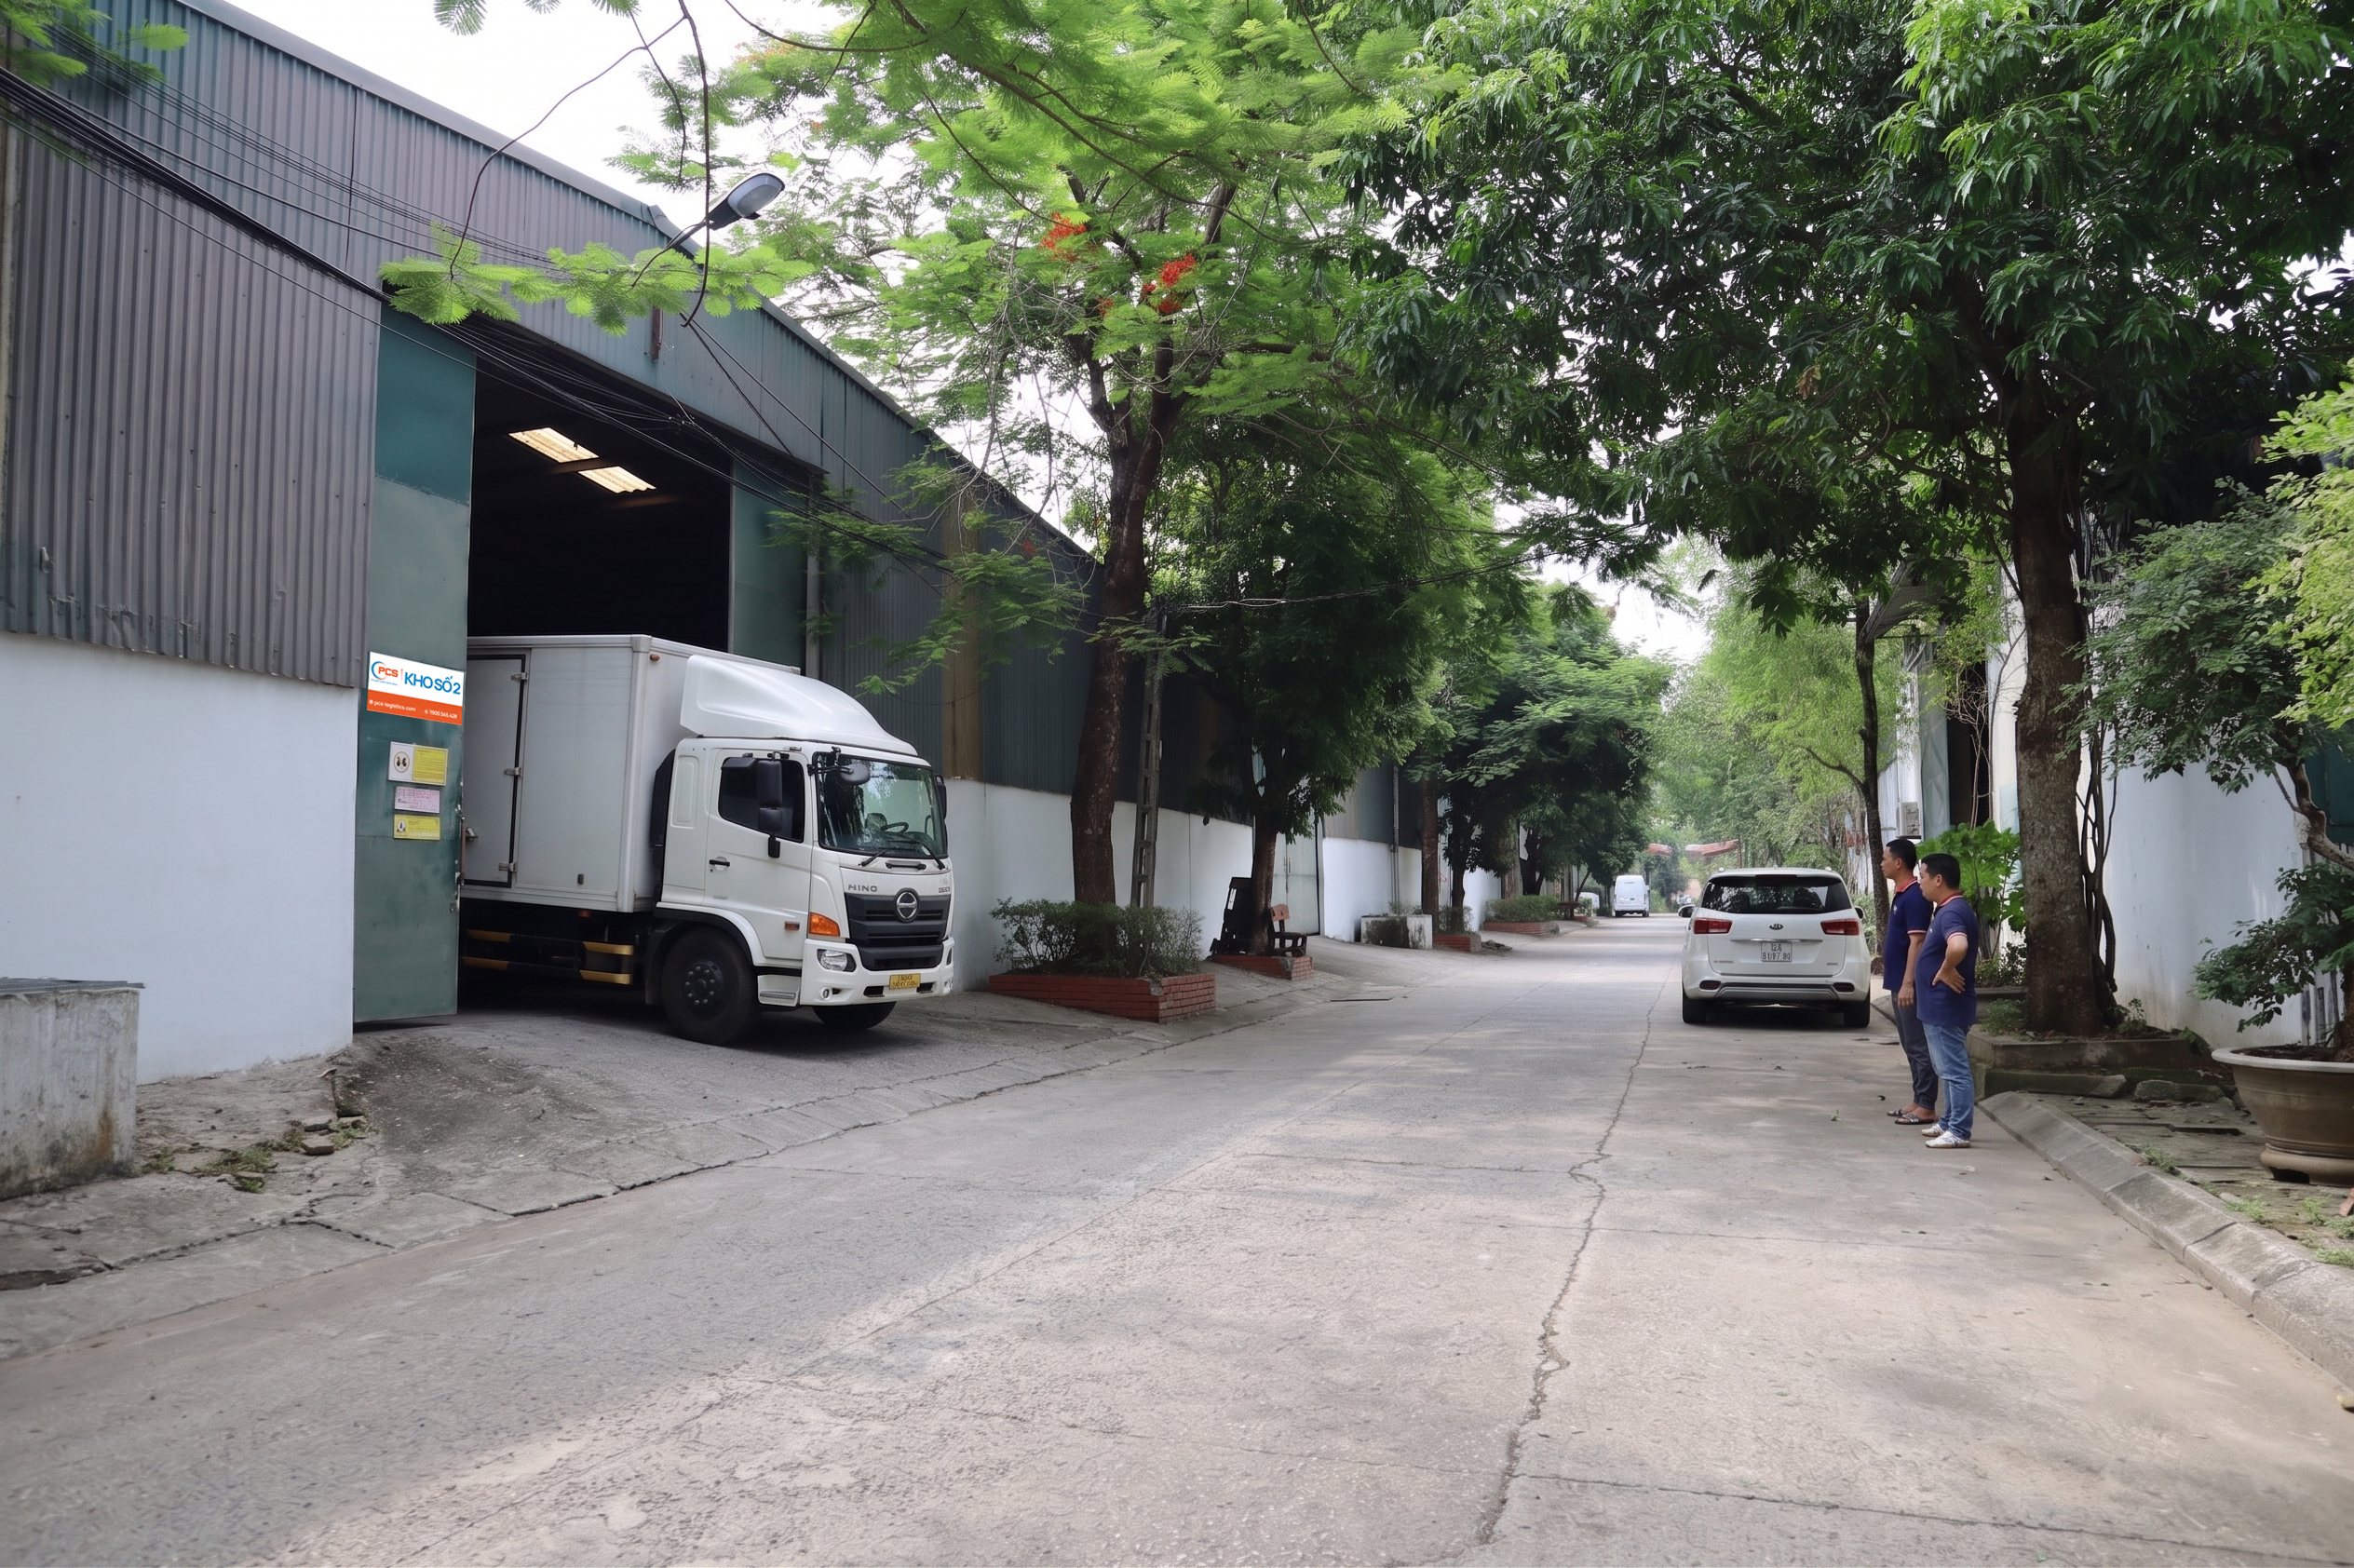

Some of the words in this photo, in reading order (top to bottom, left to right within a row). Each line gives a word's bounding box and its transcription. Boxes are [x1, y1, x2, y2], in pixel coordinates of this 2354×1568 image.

[378, 666, 399, 678] PCS
[404, 671, 433, 689] KHO
[434, 675, 453, 693] SỐ
[453, 682, 461, 696] 2
[373, 700, 416, 712] pcs-logistics.com
[848, 884, 877, 892] HINO
